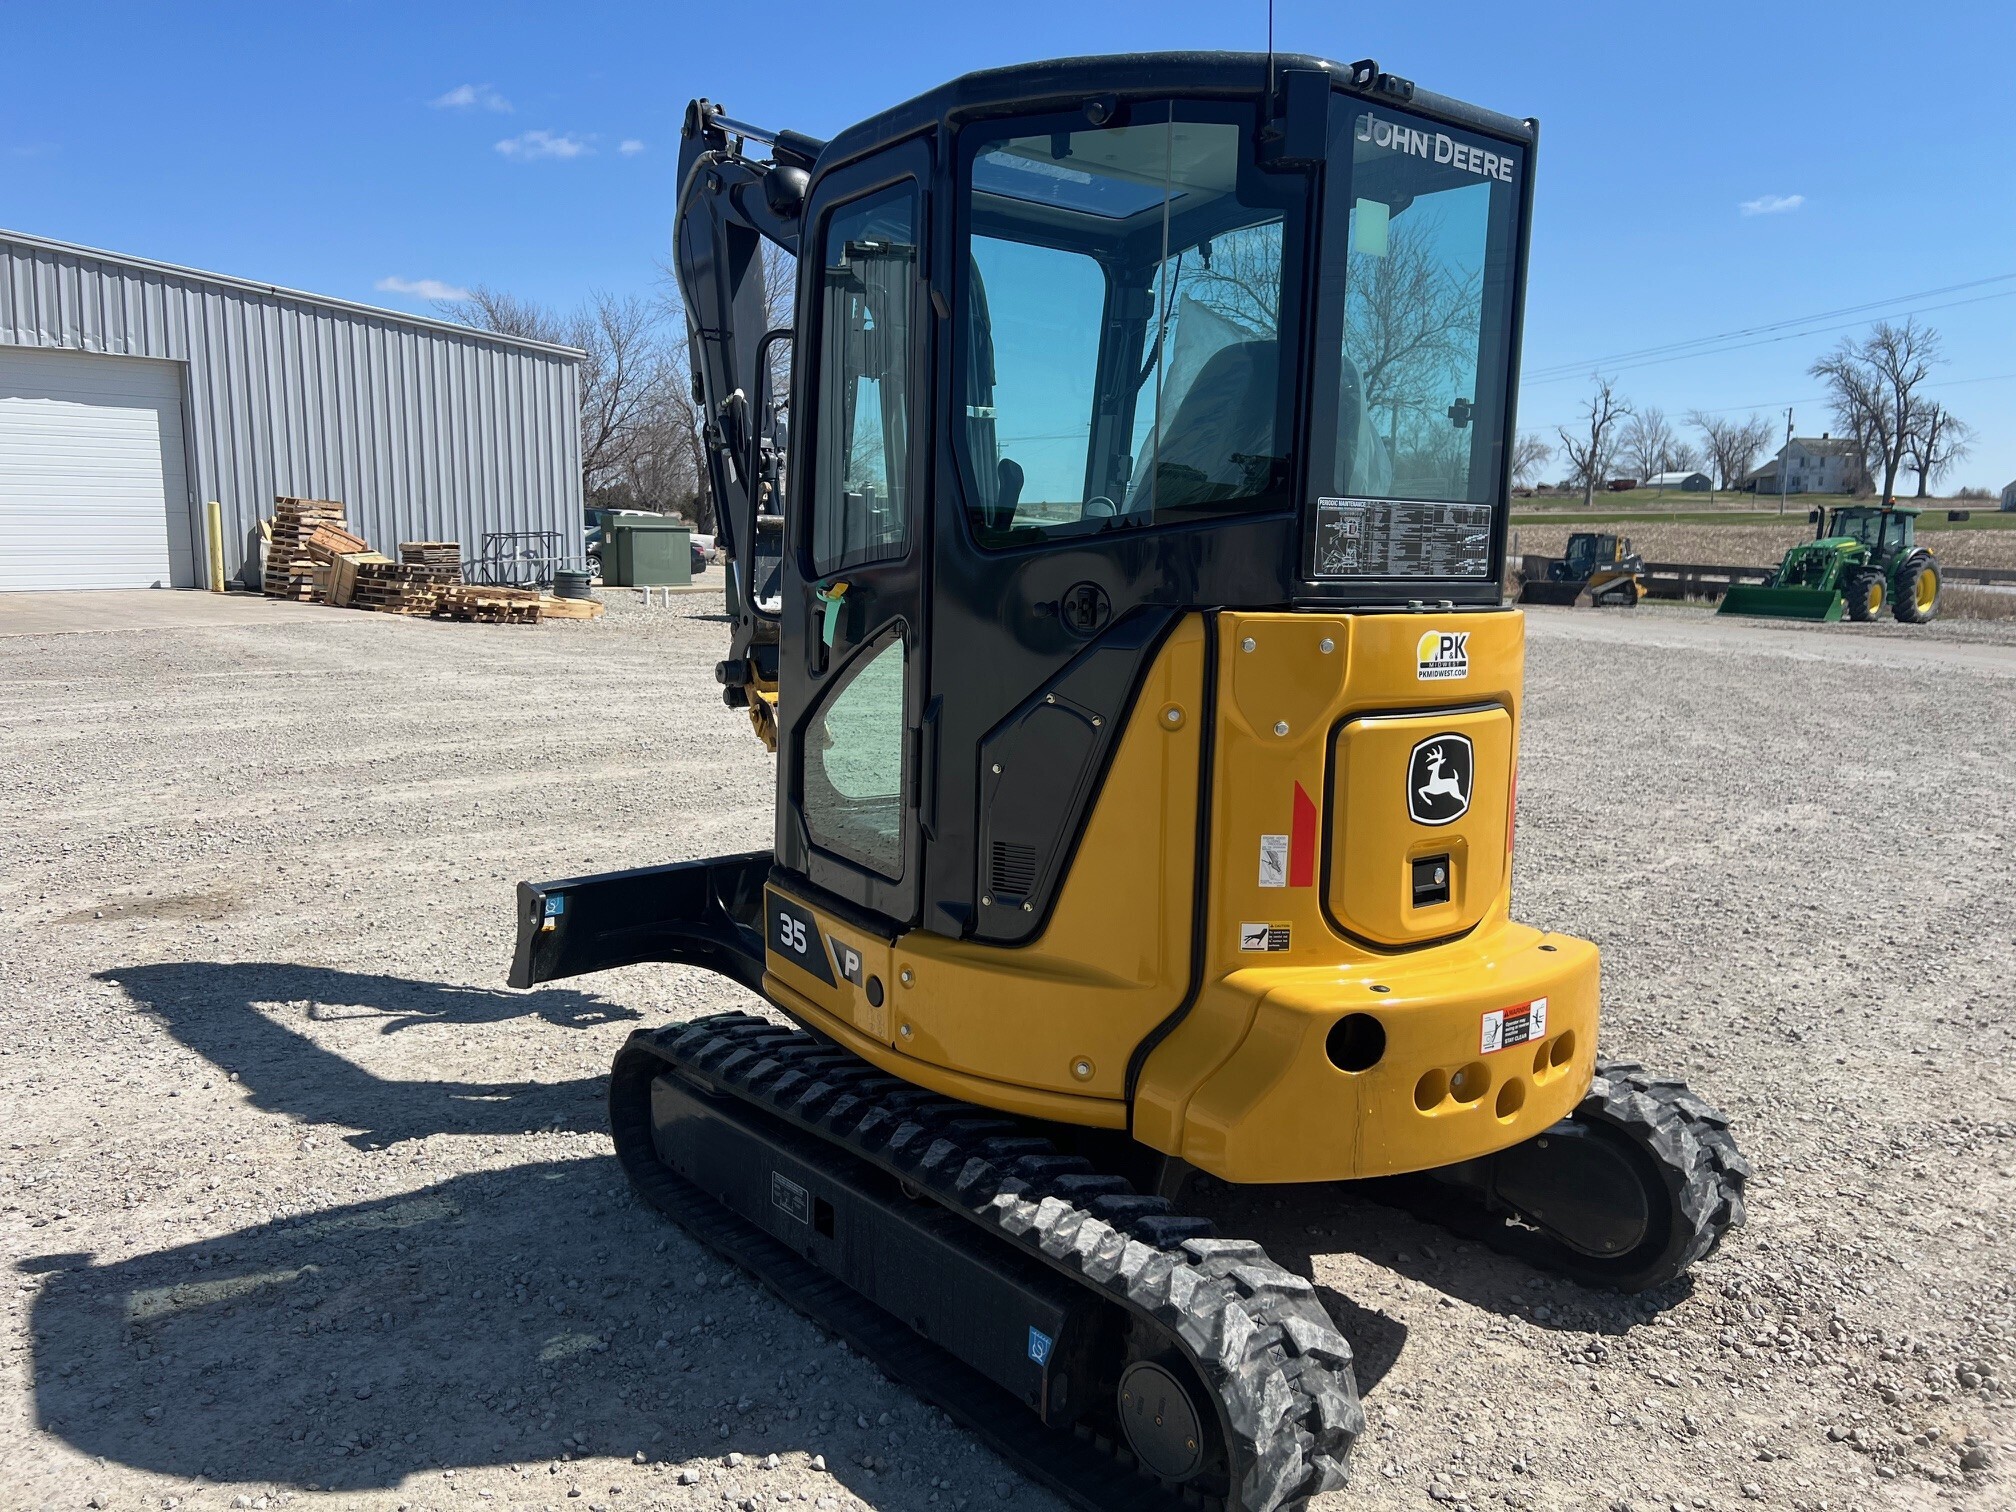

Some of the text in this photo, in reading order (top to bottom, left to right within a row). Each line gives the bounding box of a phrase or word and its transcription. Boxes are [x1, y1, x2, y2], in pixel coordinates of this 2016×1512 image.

[1357, 112, 1514, 183] JOHN DEERE
[1419, 670, 1466, 678] PKMIDWEST.COM
[780, 912, 807, 954] 35
[844, 949, 859, 977] P
[1508, 1005, 1530, 1016] WARNING
[1515, 1033, 1527, 1041] CLEAR
